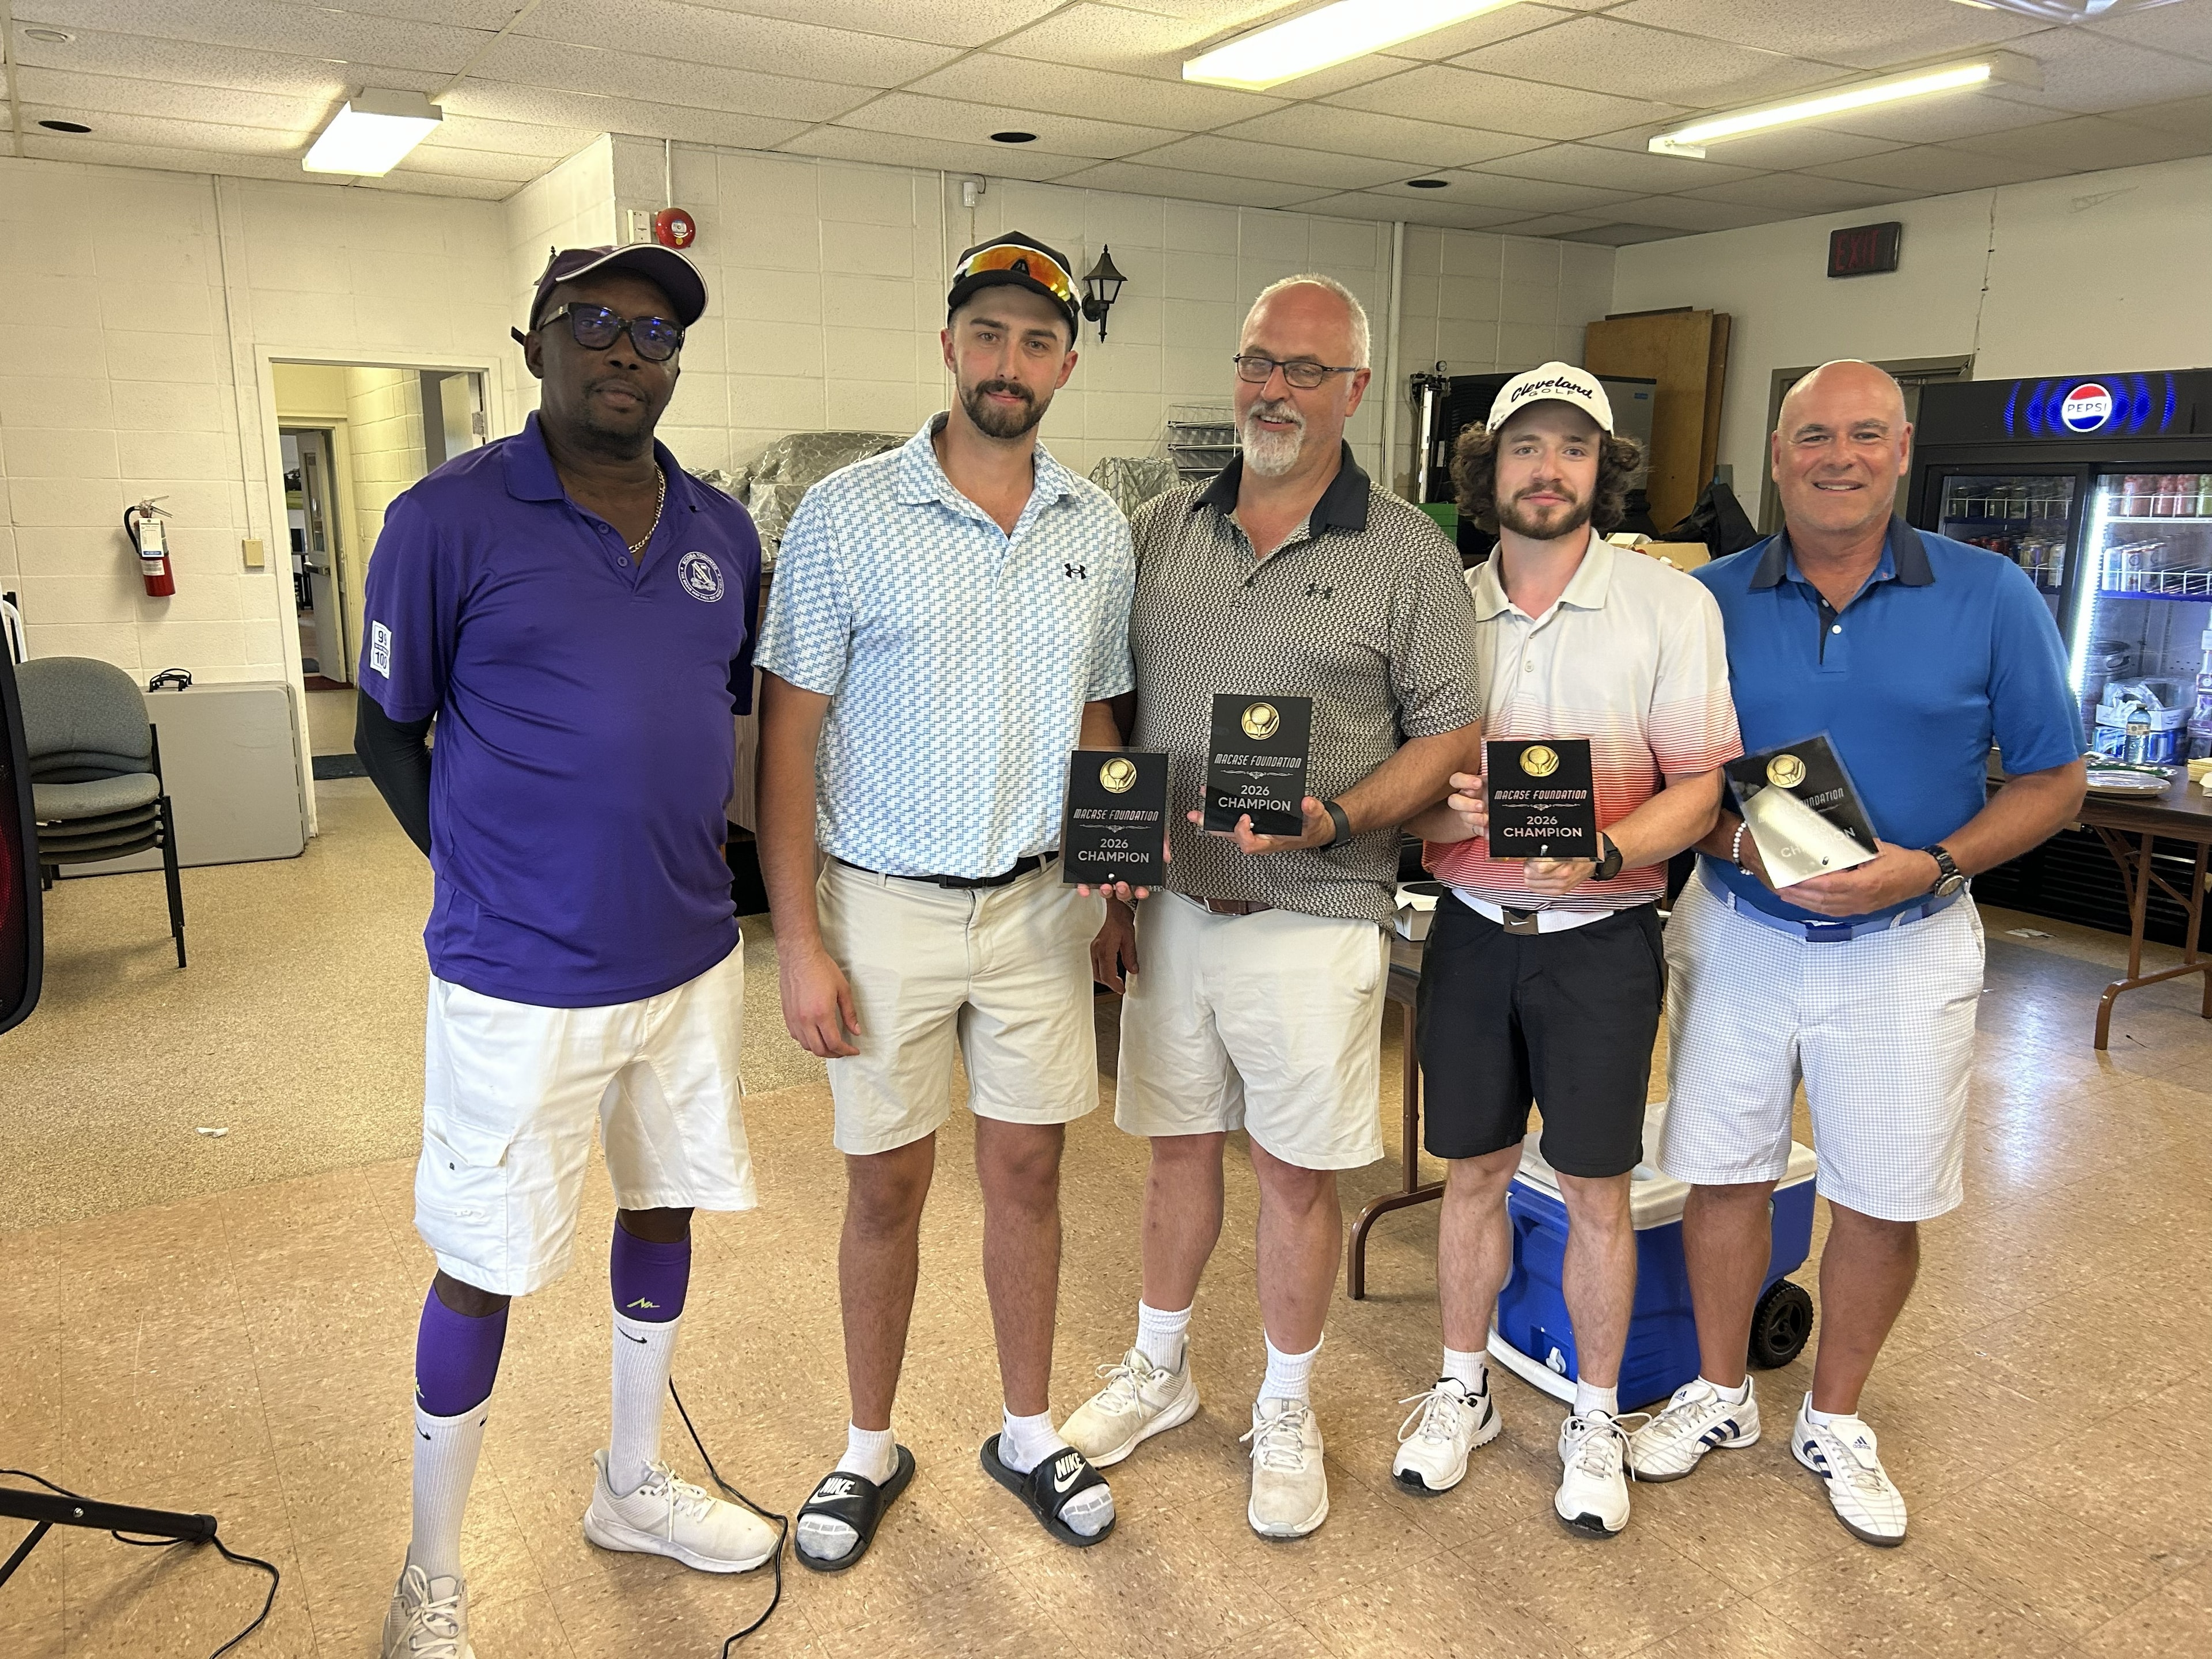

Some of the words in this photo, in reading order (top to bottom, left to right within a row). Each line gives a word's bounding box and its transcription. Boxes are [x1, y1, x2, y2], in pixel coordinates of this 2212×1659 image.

[1834, 230, 1879, 271] EXIT
[1511, 376, 1592, 403] Cleveland
[1528, 388, 1574, 397] GOLF
[2067, 403, 2107, 412] PEPSI
[378, 630, 387, 646] 99
[375, 652, 387, 669] 100
[1214, 753, 1249, 766] MACASE
[1250, 755, 1302, 768] FOUNDATION
[1240, 785, 1270, 796] 2026
[1494, 790, 1532, 800] MACASE
[1533, 790, 1588, 800] FOUNDATION
[1218, 797, 1291, 811] CHAMPION
[1073, 808, 1108, 820] MACASE
[1108, 810, 1159, 821] FOUNDATION
[1527, 816, 1558, 825] 2026
[1503, 827, 1583, 838] CHAMPION
[1100, 838, 1129, 849] 2026
[1078, 850, 1150, 863] CHAMPION
[1055, 1452, 1082, 1479] NIKE
[819, 1478, 855, 1495] NIKE
